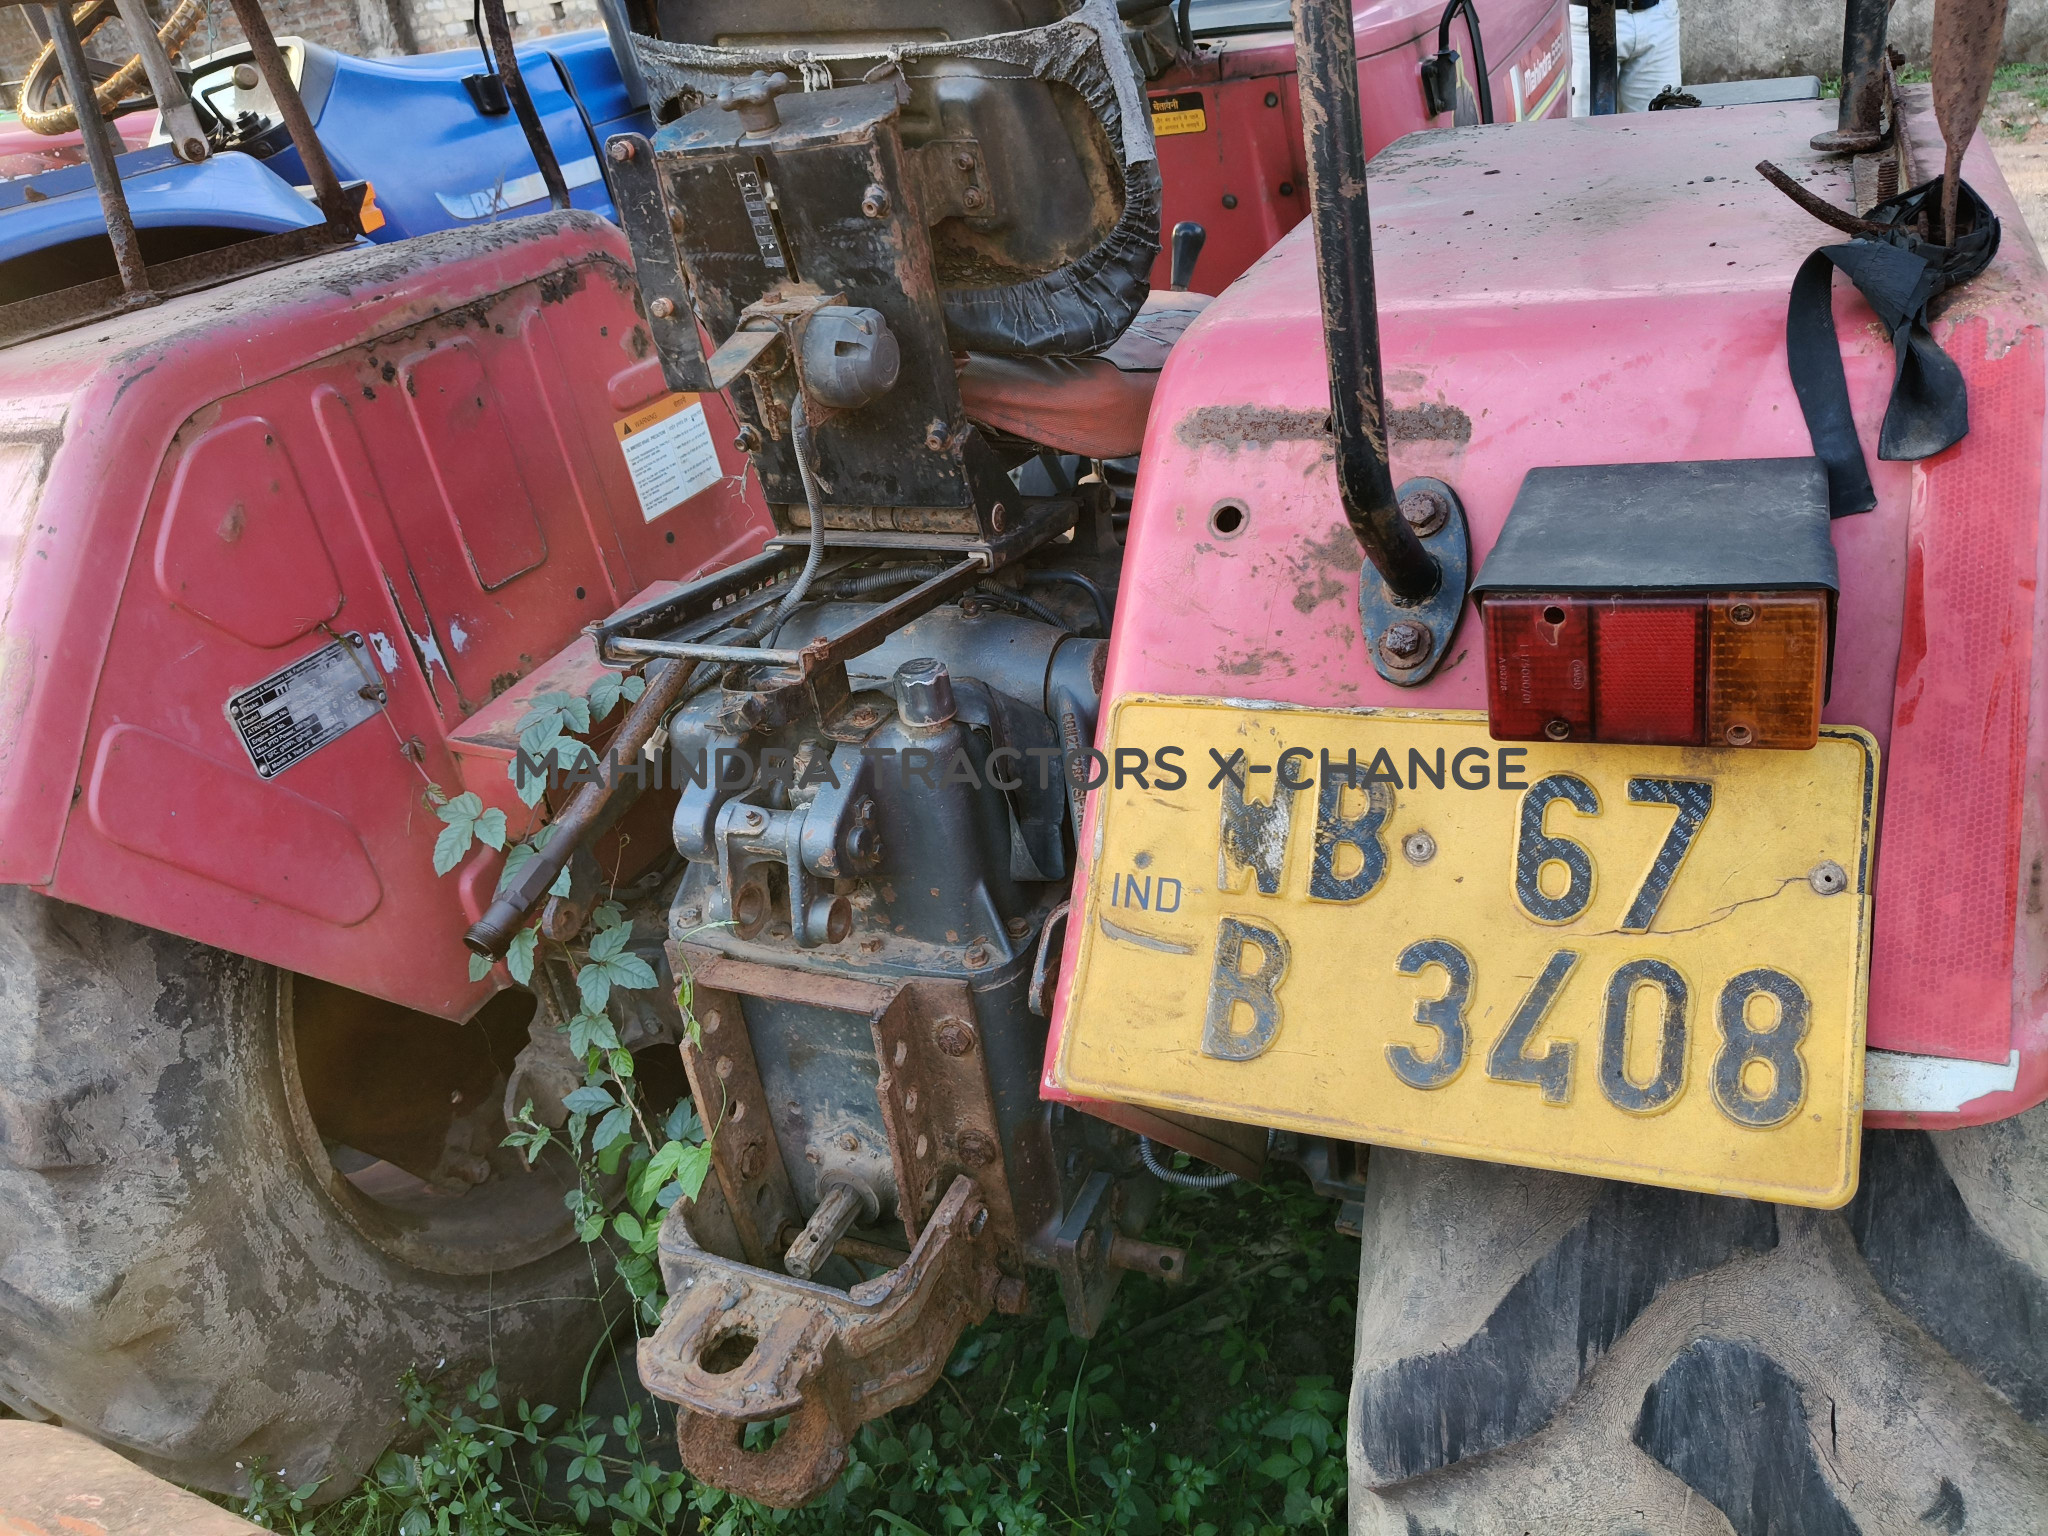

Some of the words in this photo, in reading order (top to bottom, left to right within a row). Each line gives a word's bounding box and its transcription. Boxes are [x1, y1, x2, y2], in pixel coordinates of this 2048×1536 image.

[1524, 51, 1551, 98] Mahindra
[635, 412, 658, 428] WARNING
[1217, 752, 1396, 903] WB
[1515, 773, 1713, 931] 67
[1112, 873, 1181, 913] IND
[1203, 915, 1291, 1063] B
[1386, 938, 1810, 1130] 3408
